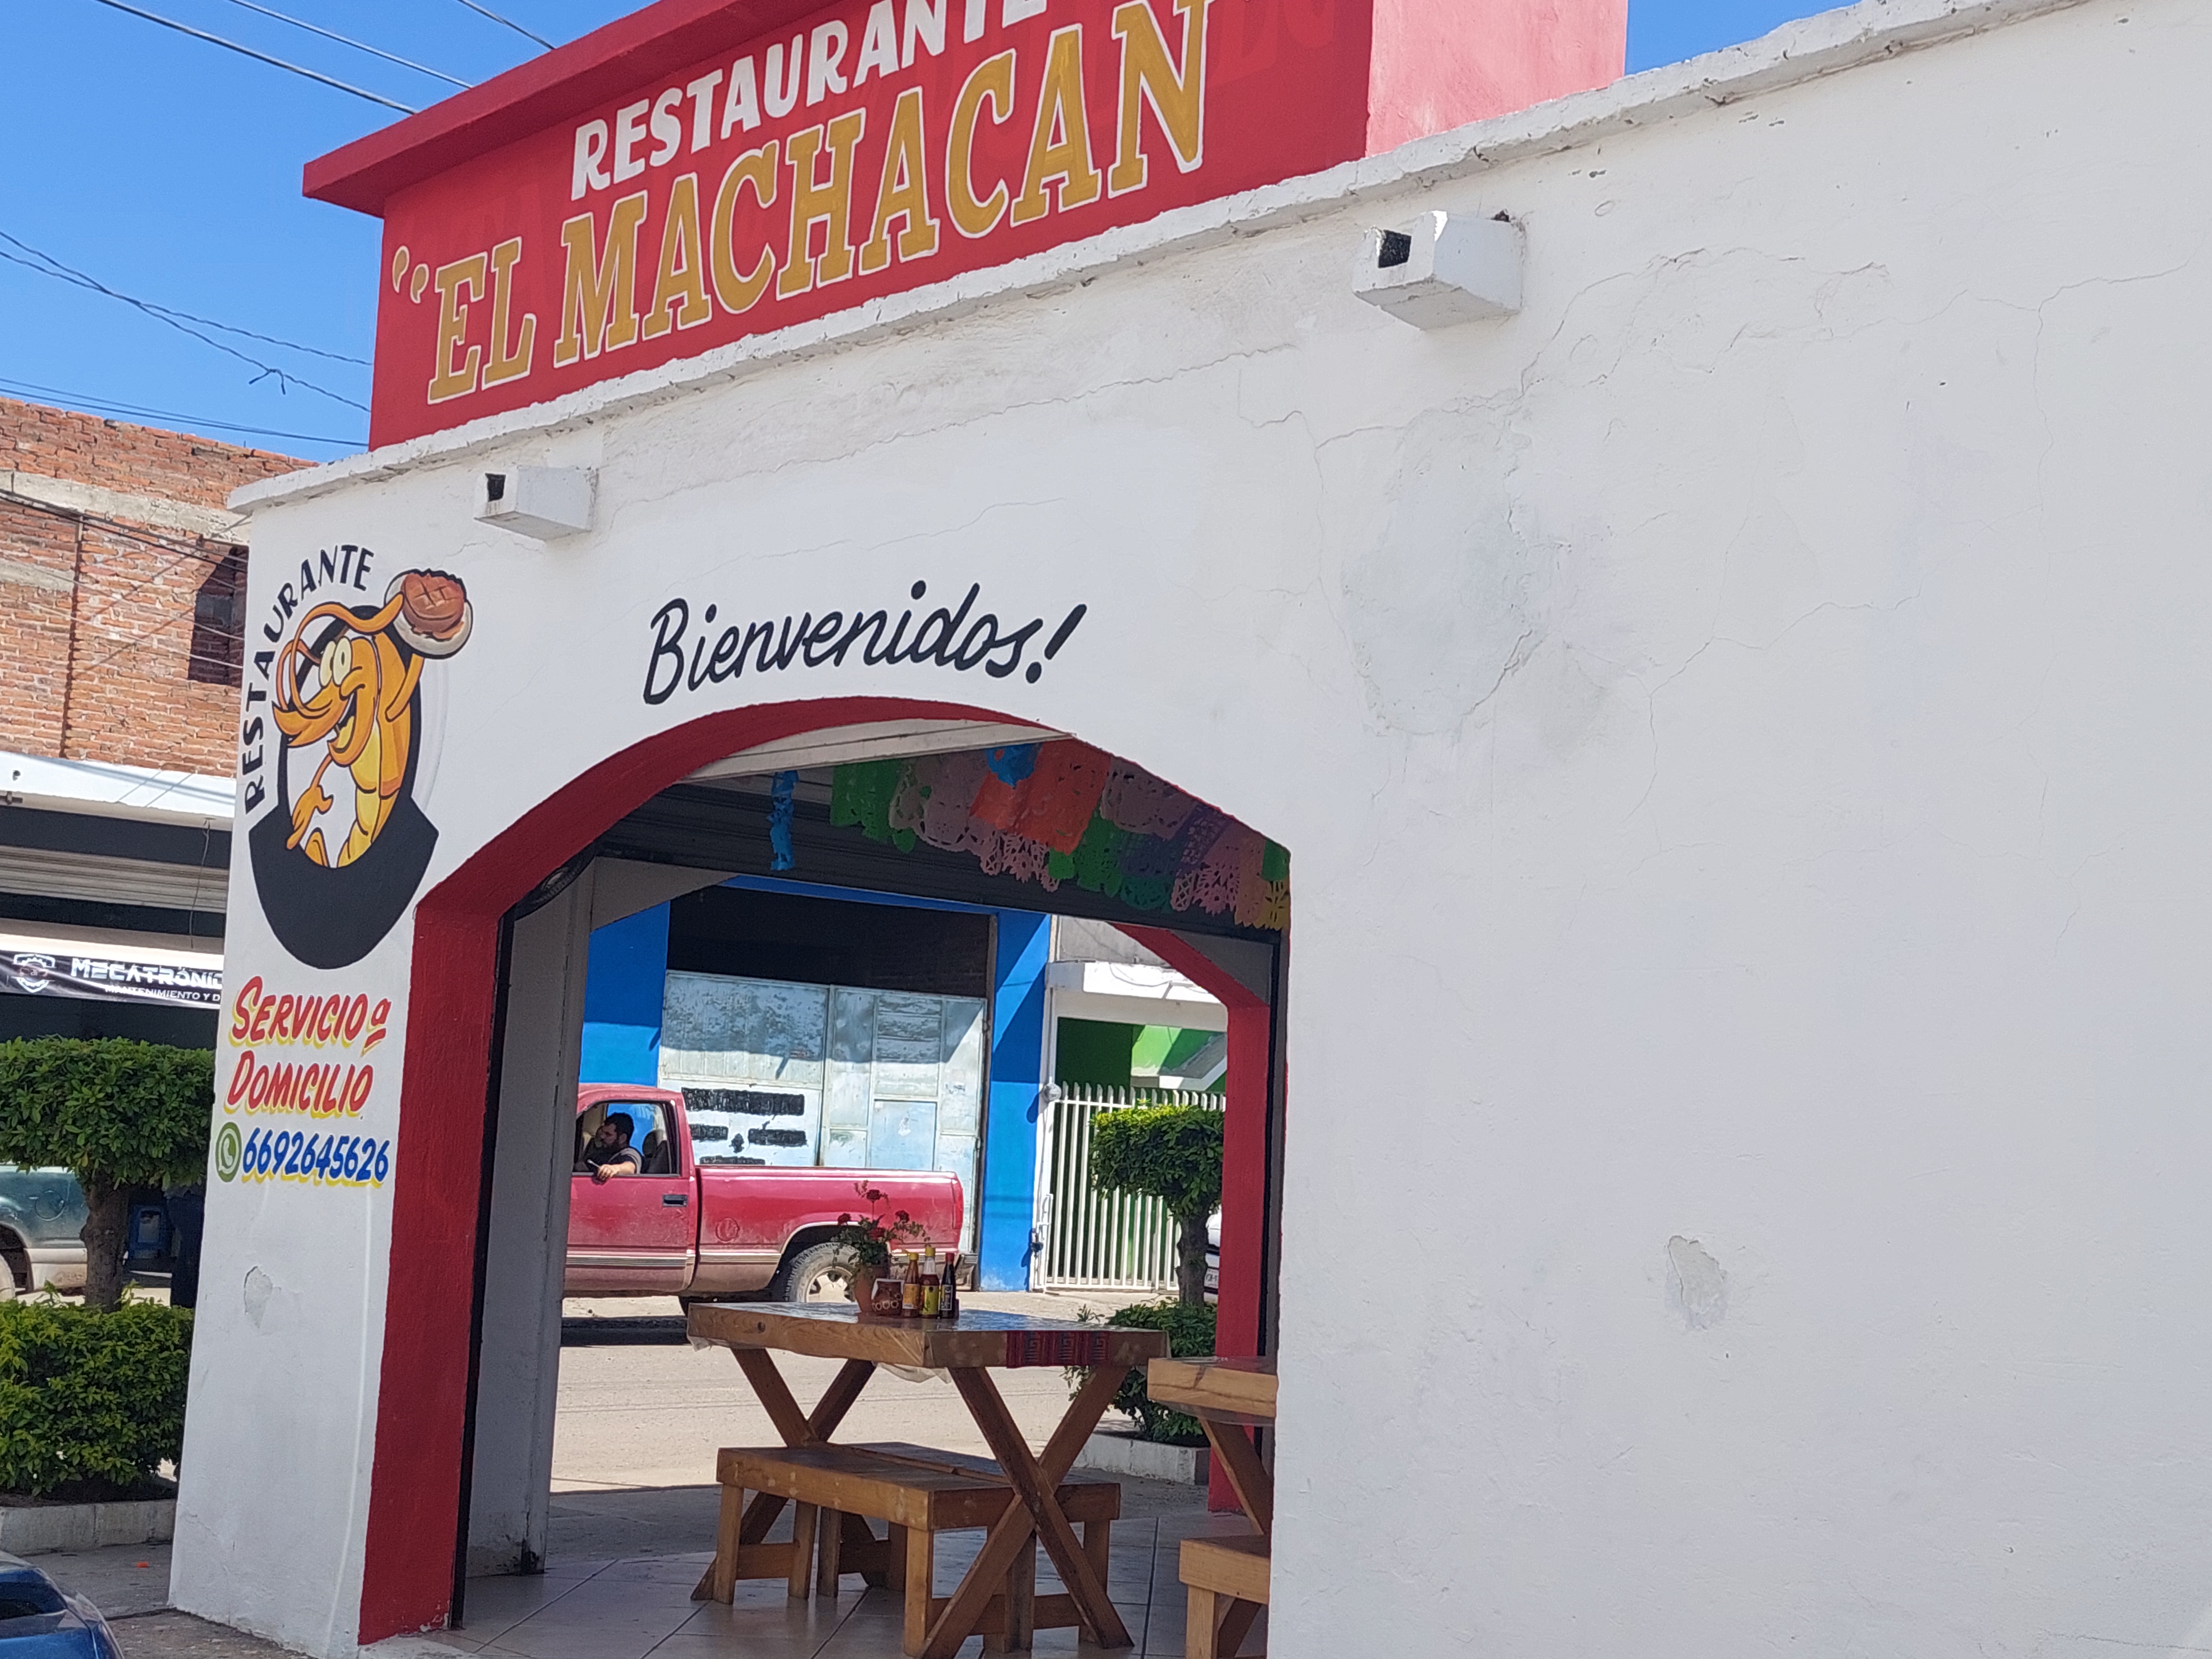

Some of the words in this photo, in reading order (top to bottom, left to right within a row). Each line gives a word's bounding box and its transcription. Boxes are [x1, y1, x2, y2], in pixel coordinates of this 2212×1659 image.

[553, 0, 1215, 368] MACHACAN
[242, 544, 374, 815] RESTAURANTE
[642, 580, 1088, 705] Bienvenidos!
[229, 976, 368, 1048] SERVICIO
[223, 1050, 373, 1117] DOMICILIO
[242, 1128, 390, 1187] 6692645626
